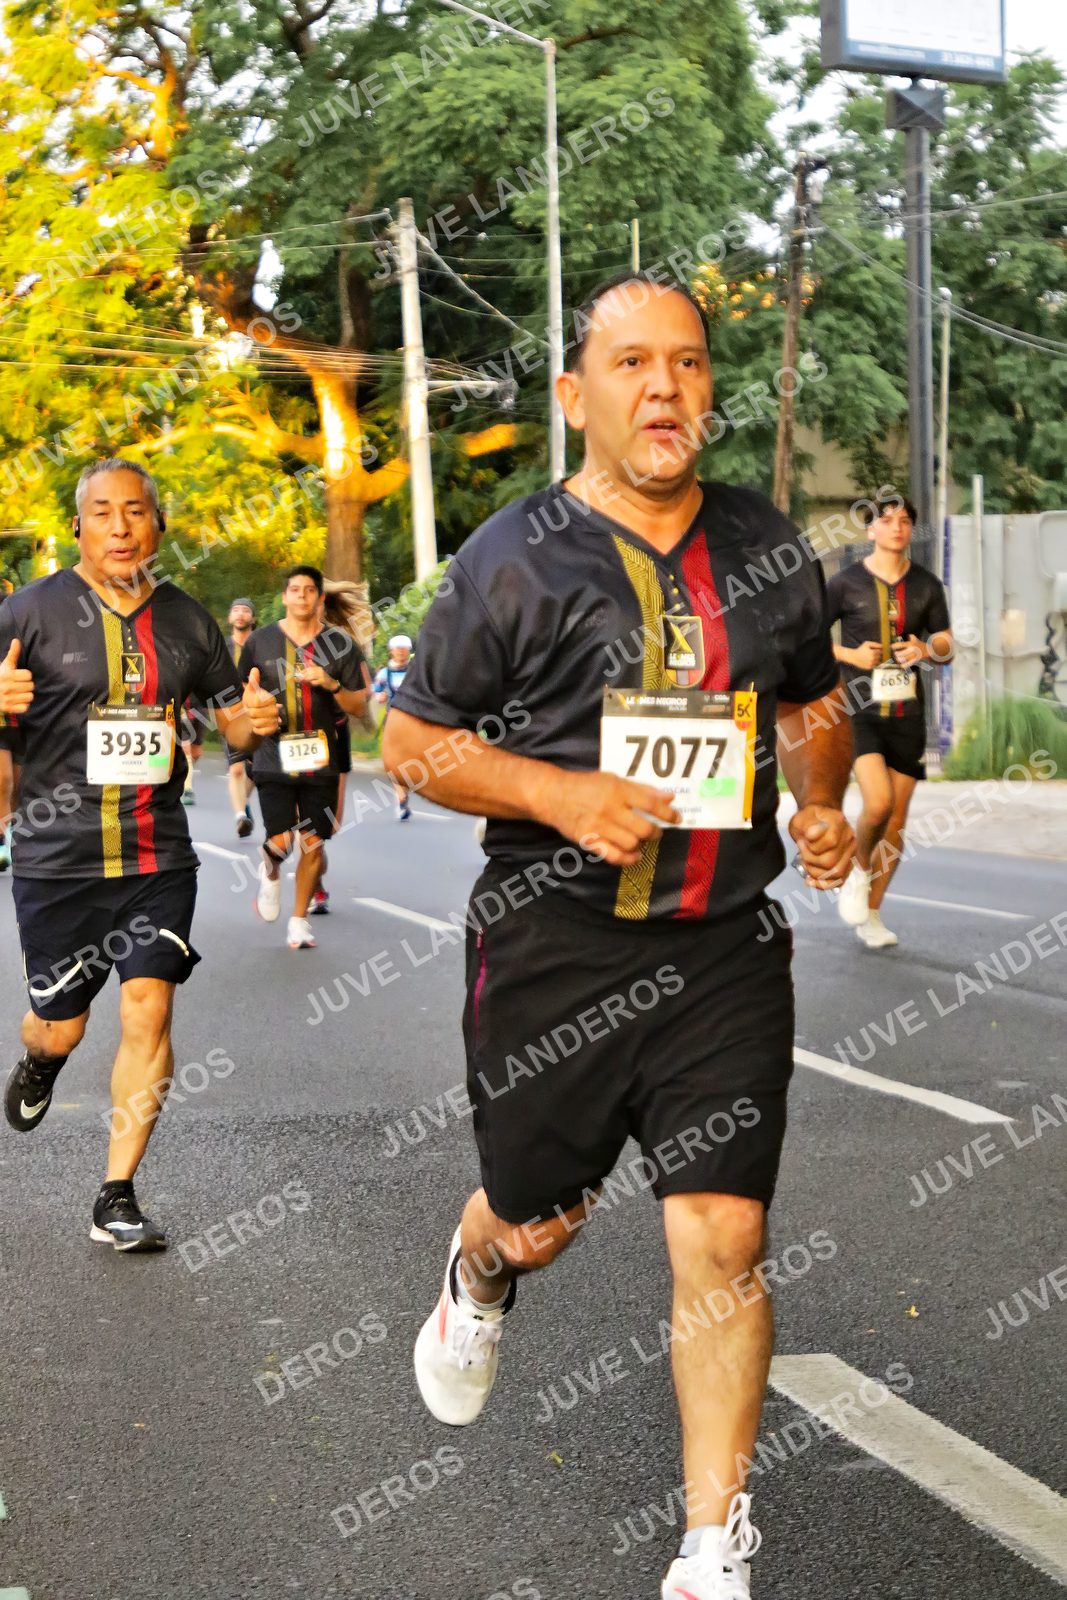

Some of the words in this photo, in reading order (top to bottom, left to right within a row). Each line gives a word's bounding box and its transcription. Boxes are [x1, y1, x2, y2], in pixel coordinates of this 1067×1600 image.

[101, 731, 161, 756] 3935
[289, 743, 318, 757] 3126
[625, 735, 728, 779] 7077
